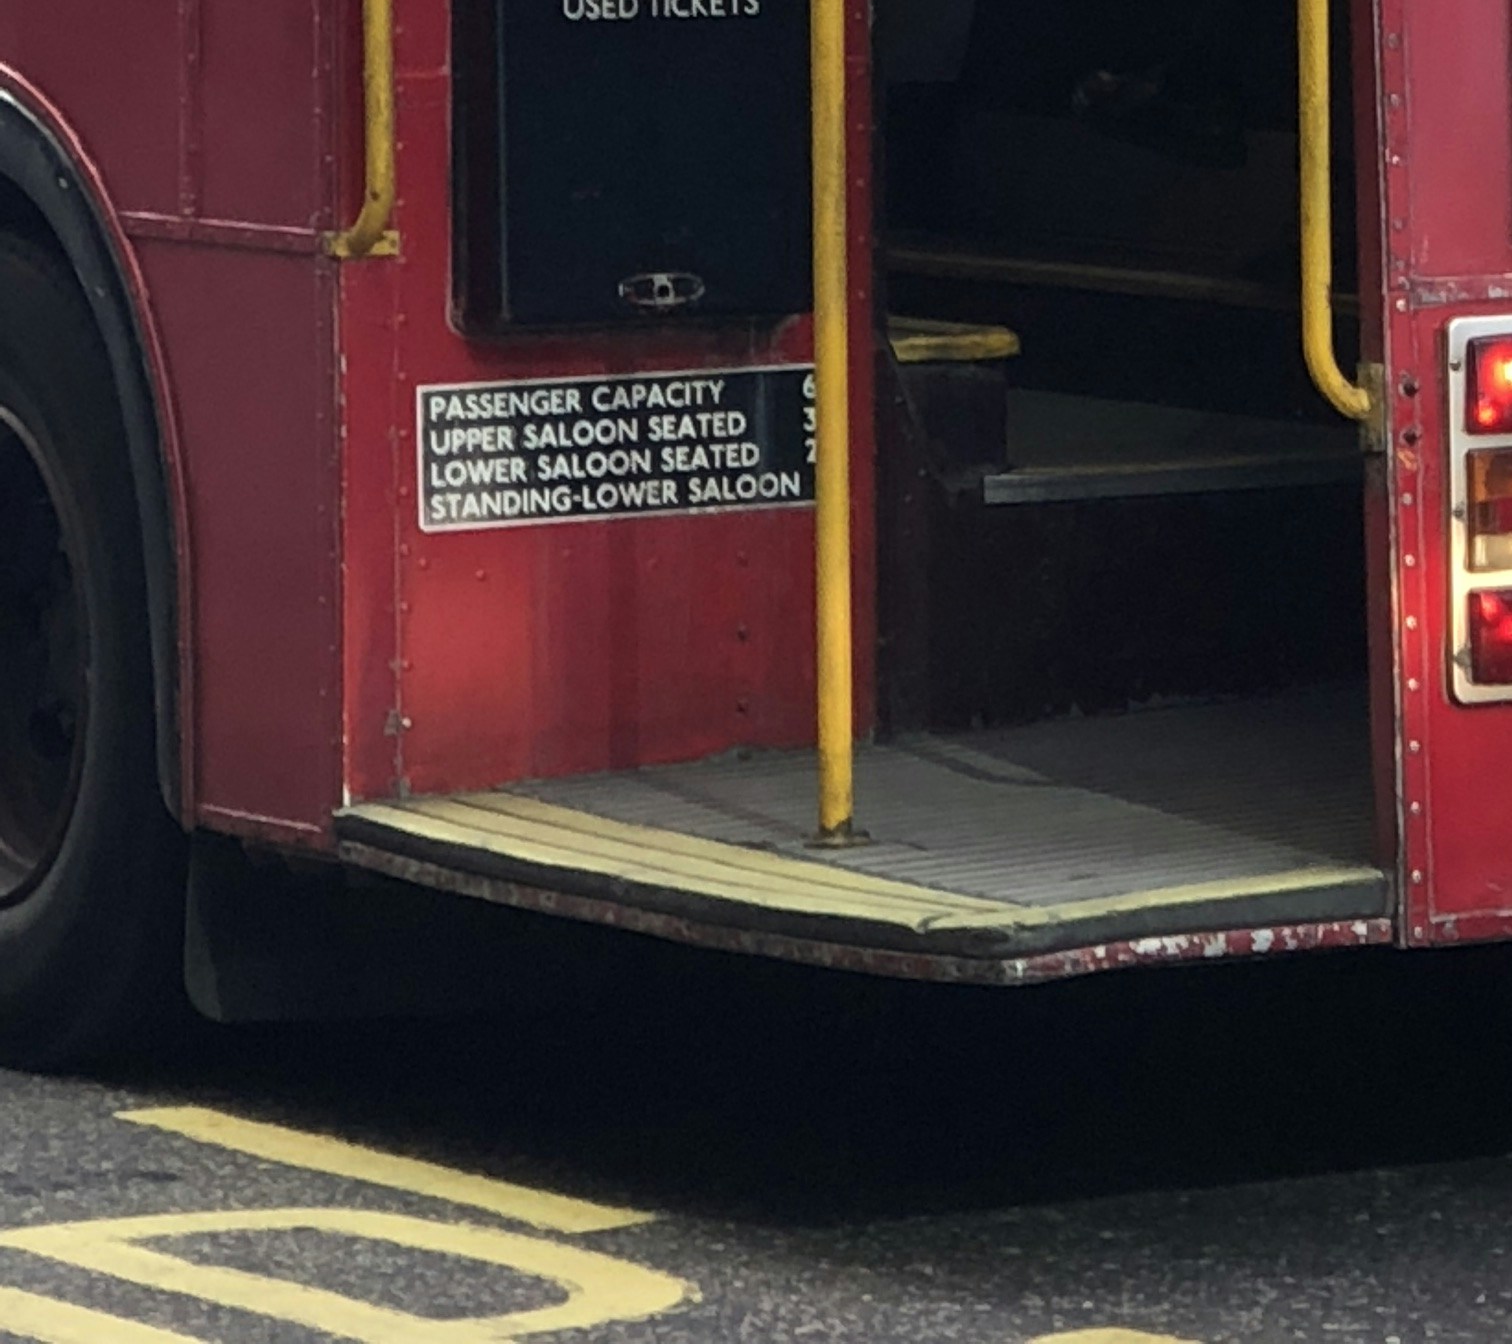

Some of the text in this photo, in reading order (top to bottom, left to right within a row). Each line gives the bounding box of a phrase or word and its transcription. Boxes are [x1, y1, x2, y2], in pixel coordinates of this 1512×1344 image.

[429, 388, 582, 422] PASSENGER
[591, 380, 726, 412] CAPACITY
[429, 427, 515, 455] UPPER
[524, 419, 639, 449] SALOON
[648, 410, 746, 441] SEATED
[430, 459, 528, 488] LOWER
[537, 451, 652, 480] SALOON
[660, 442, 759, 472] SEATED
[430, 472, 800, 520] STANDING-LOWER SALOON
